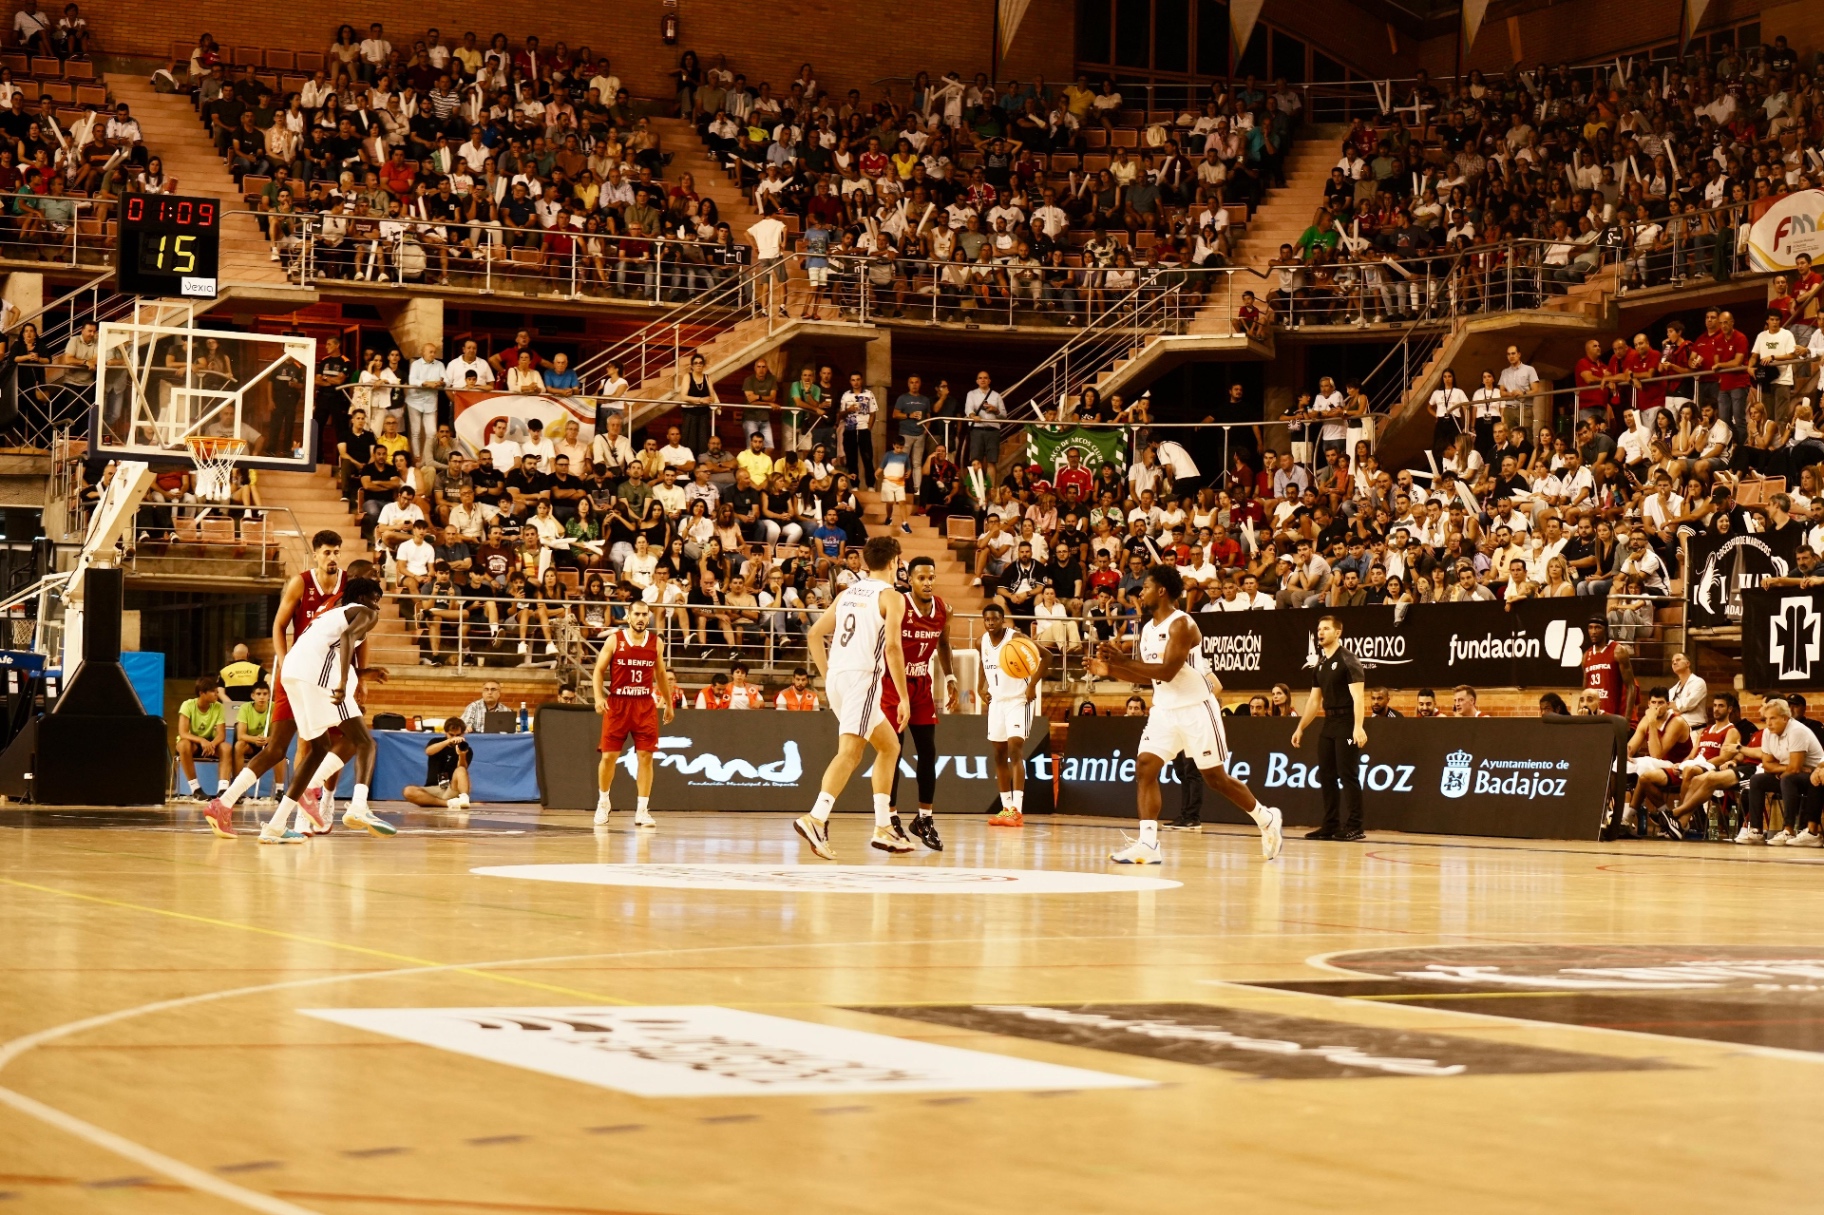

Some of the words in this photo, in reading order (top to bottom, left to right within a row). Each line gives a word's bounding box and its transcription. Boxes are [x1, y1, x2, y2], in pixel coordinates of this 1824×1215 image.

[127, 198, 213, 226] 01:09
[157, 235, 197, 272] 15
[184, 281, 214, 293] Vexia
[840, 613, 857, 648] 9
[902, 629, 913, 638] SL
[1203, 629, 1262, 654] DIPUTACIÓN
[1337, 635, 1406, 658] nxenxo
[1448, 630, 1541, 667] fundación
[616, 658, 626, 666] SL
[1213, 652, 1261, 672] BADAJOZ
[630, 669, 643, 683] 13
[1590, 672, 1601, 686] 33
[1480, 758, 1553, 770] Ayuntamiento
[1555, 759, 1570, 770] de
[1474, 769, 1568, 800] Badajoz
